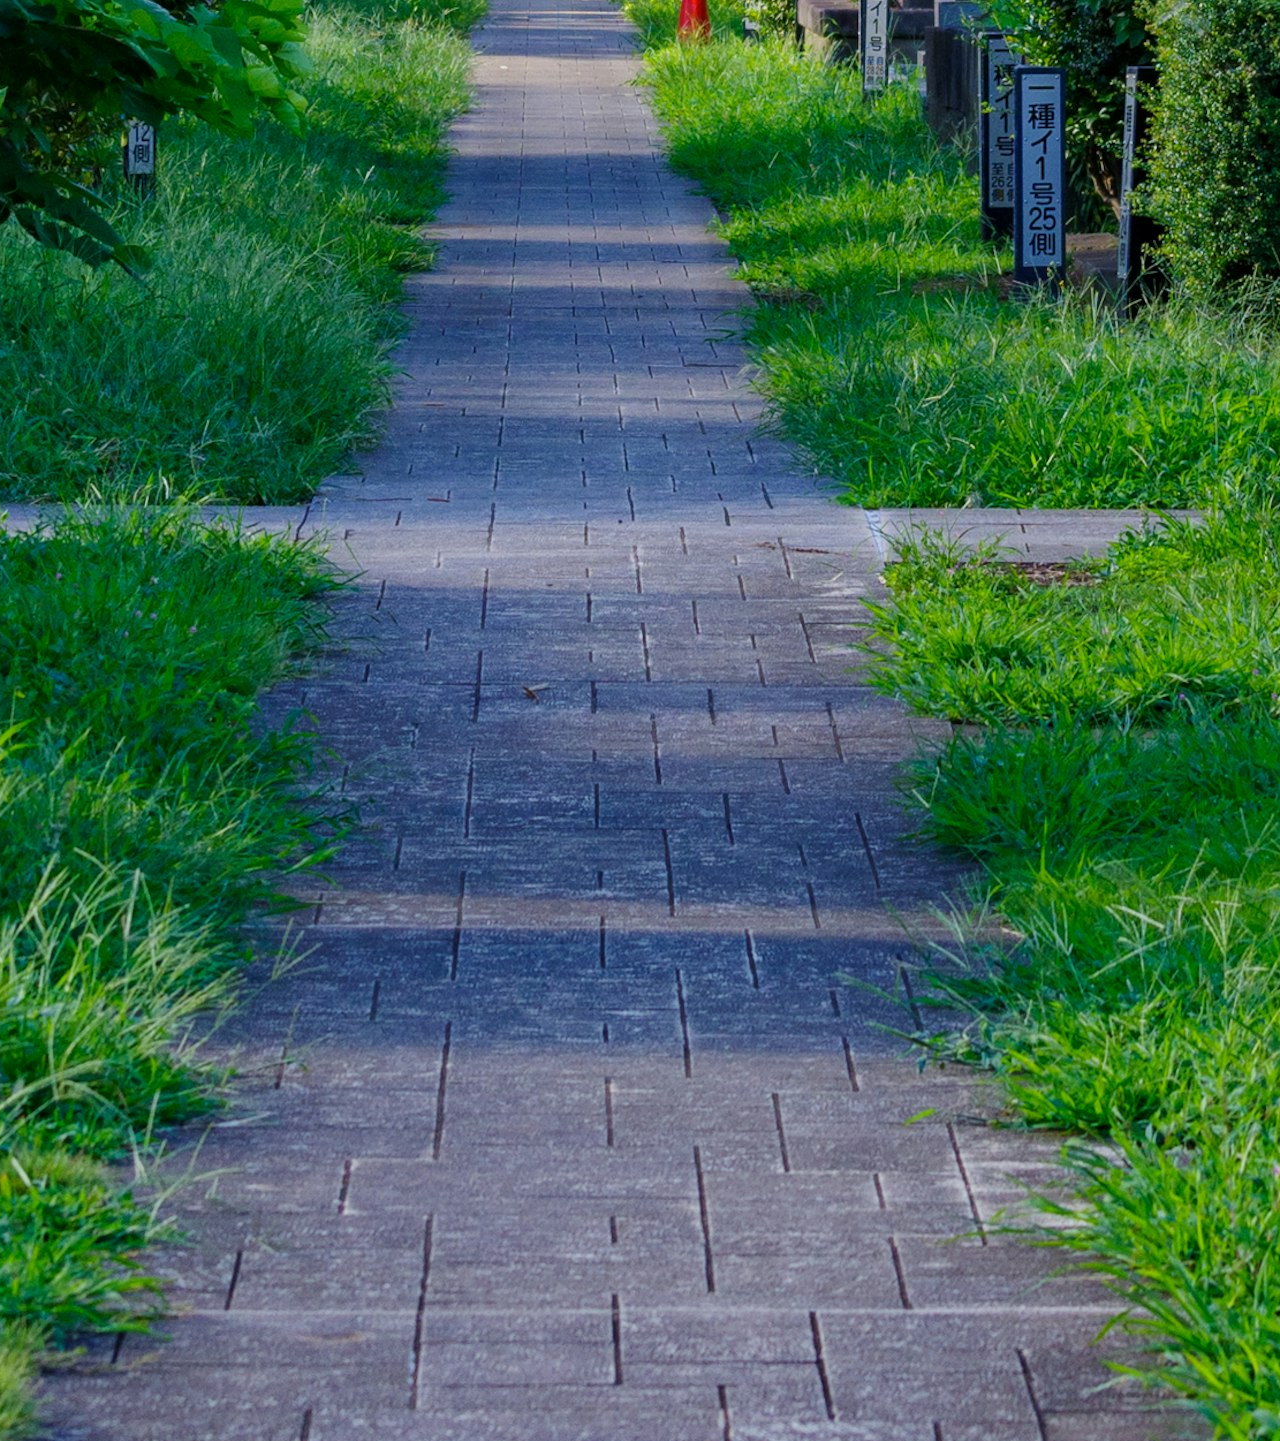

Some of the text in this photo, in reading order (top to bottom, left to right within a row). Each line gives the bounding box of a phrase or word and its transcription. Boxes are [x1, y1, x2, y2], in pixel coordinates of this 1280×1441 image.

[1028, 85, 1056, 257] 一種イ1号25側
